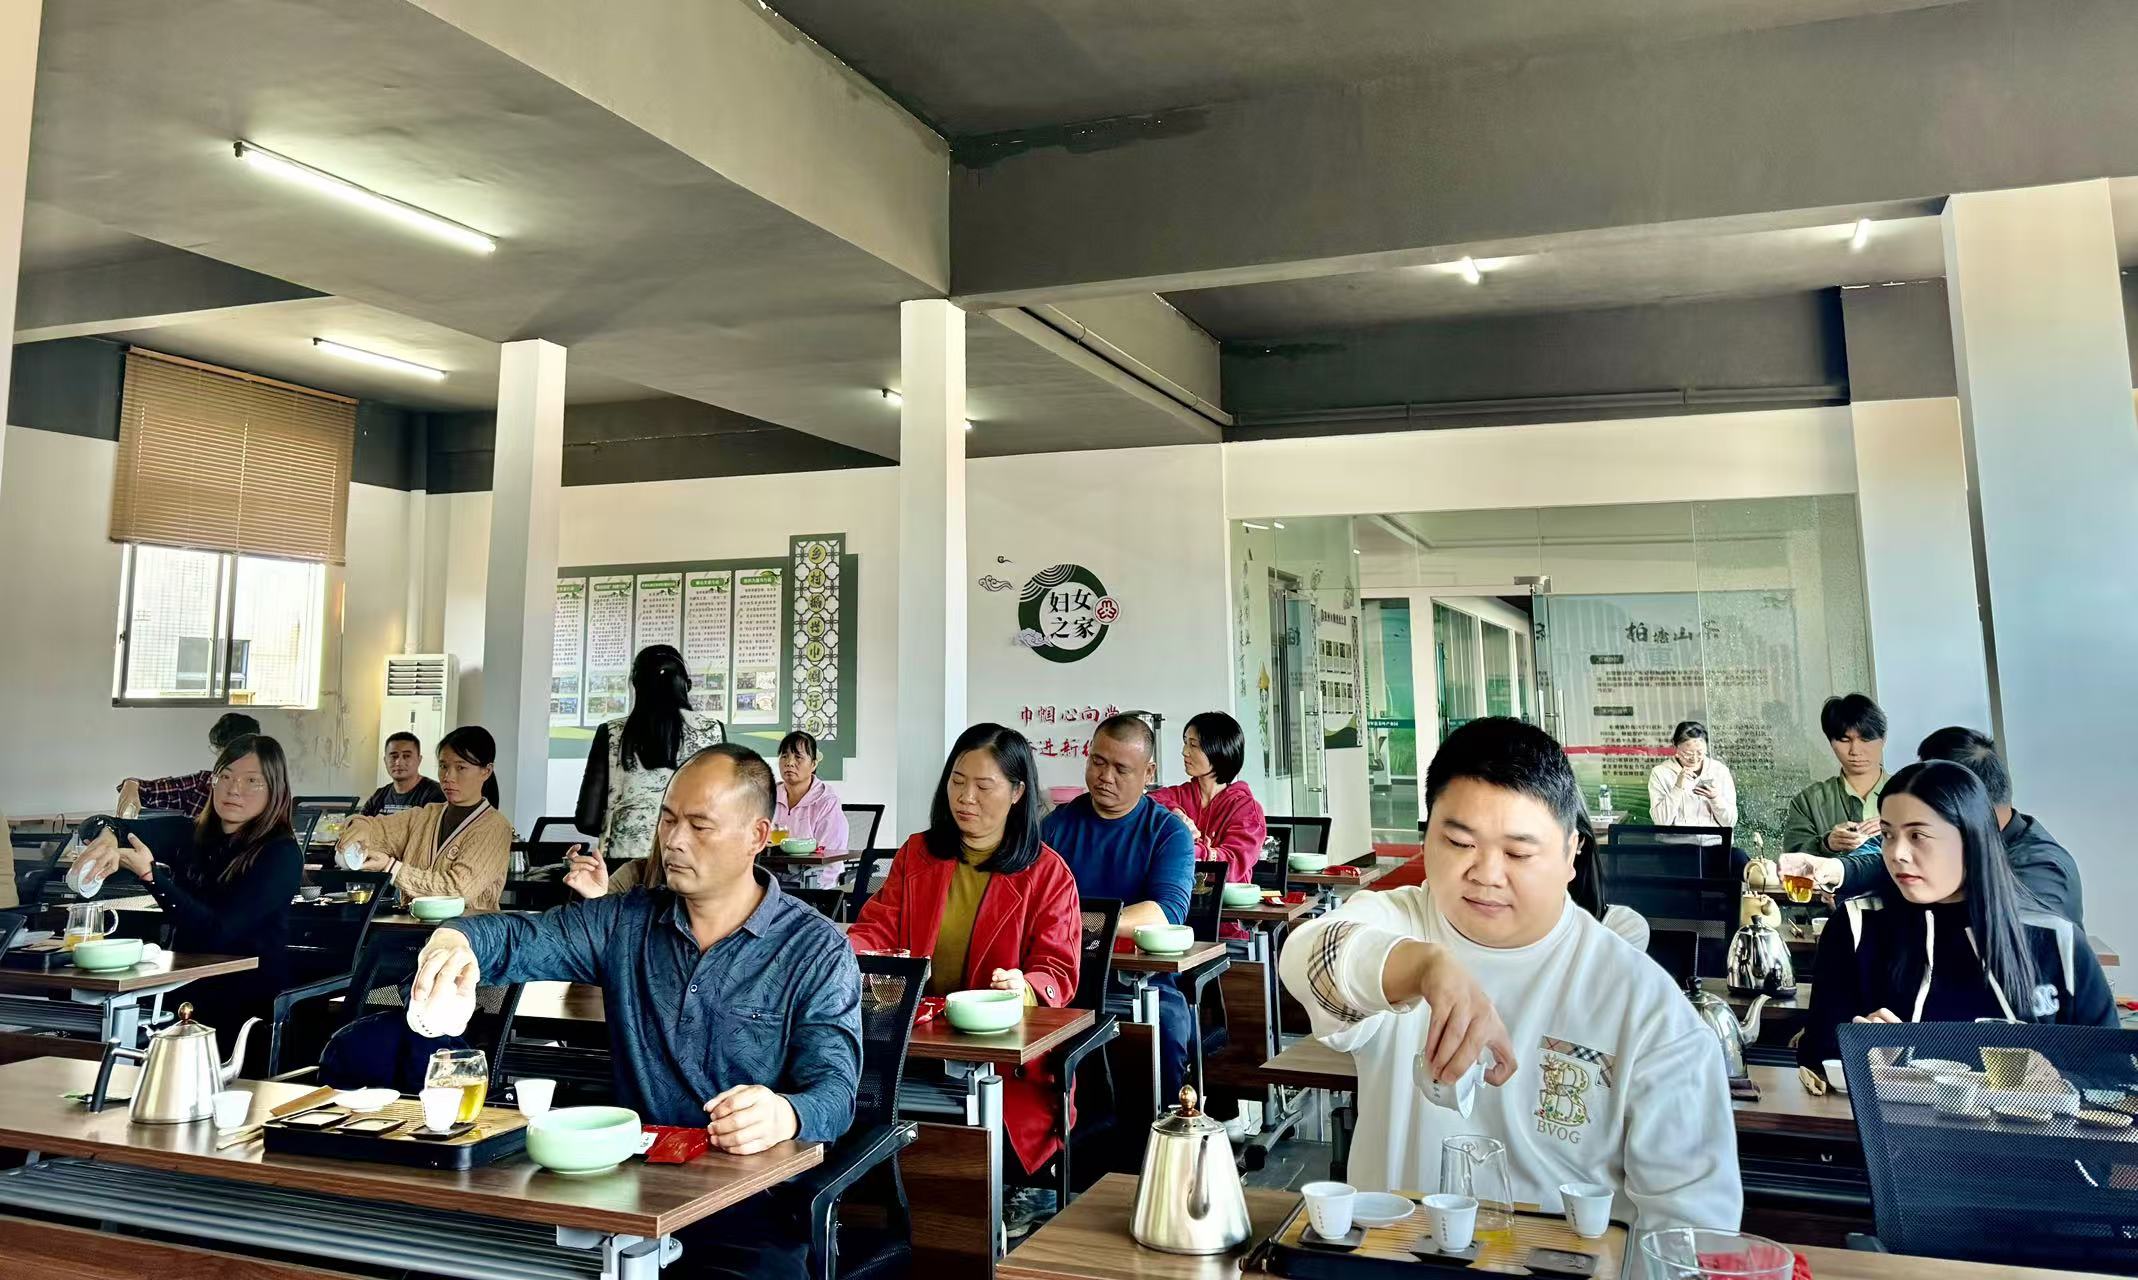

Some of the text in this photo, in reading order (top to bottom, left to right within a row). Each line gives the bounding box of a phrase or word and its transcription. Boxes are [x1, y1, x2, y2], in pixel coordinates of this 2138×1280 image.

[1049, 588, 1093, 614] 妇女
[1049, 616, 1095, 640] 之家
[1536, 1119, 1582, 1144] BVOG
